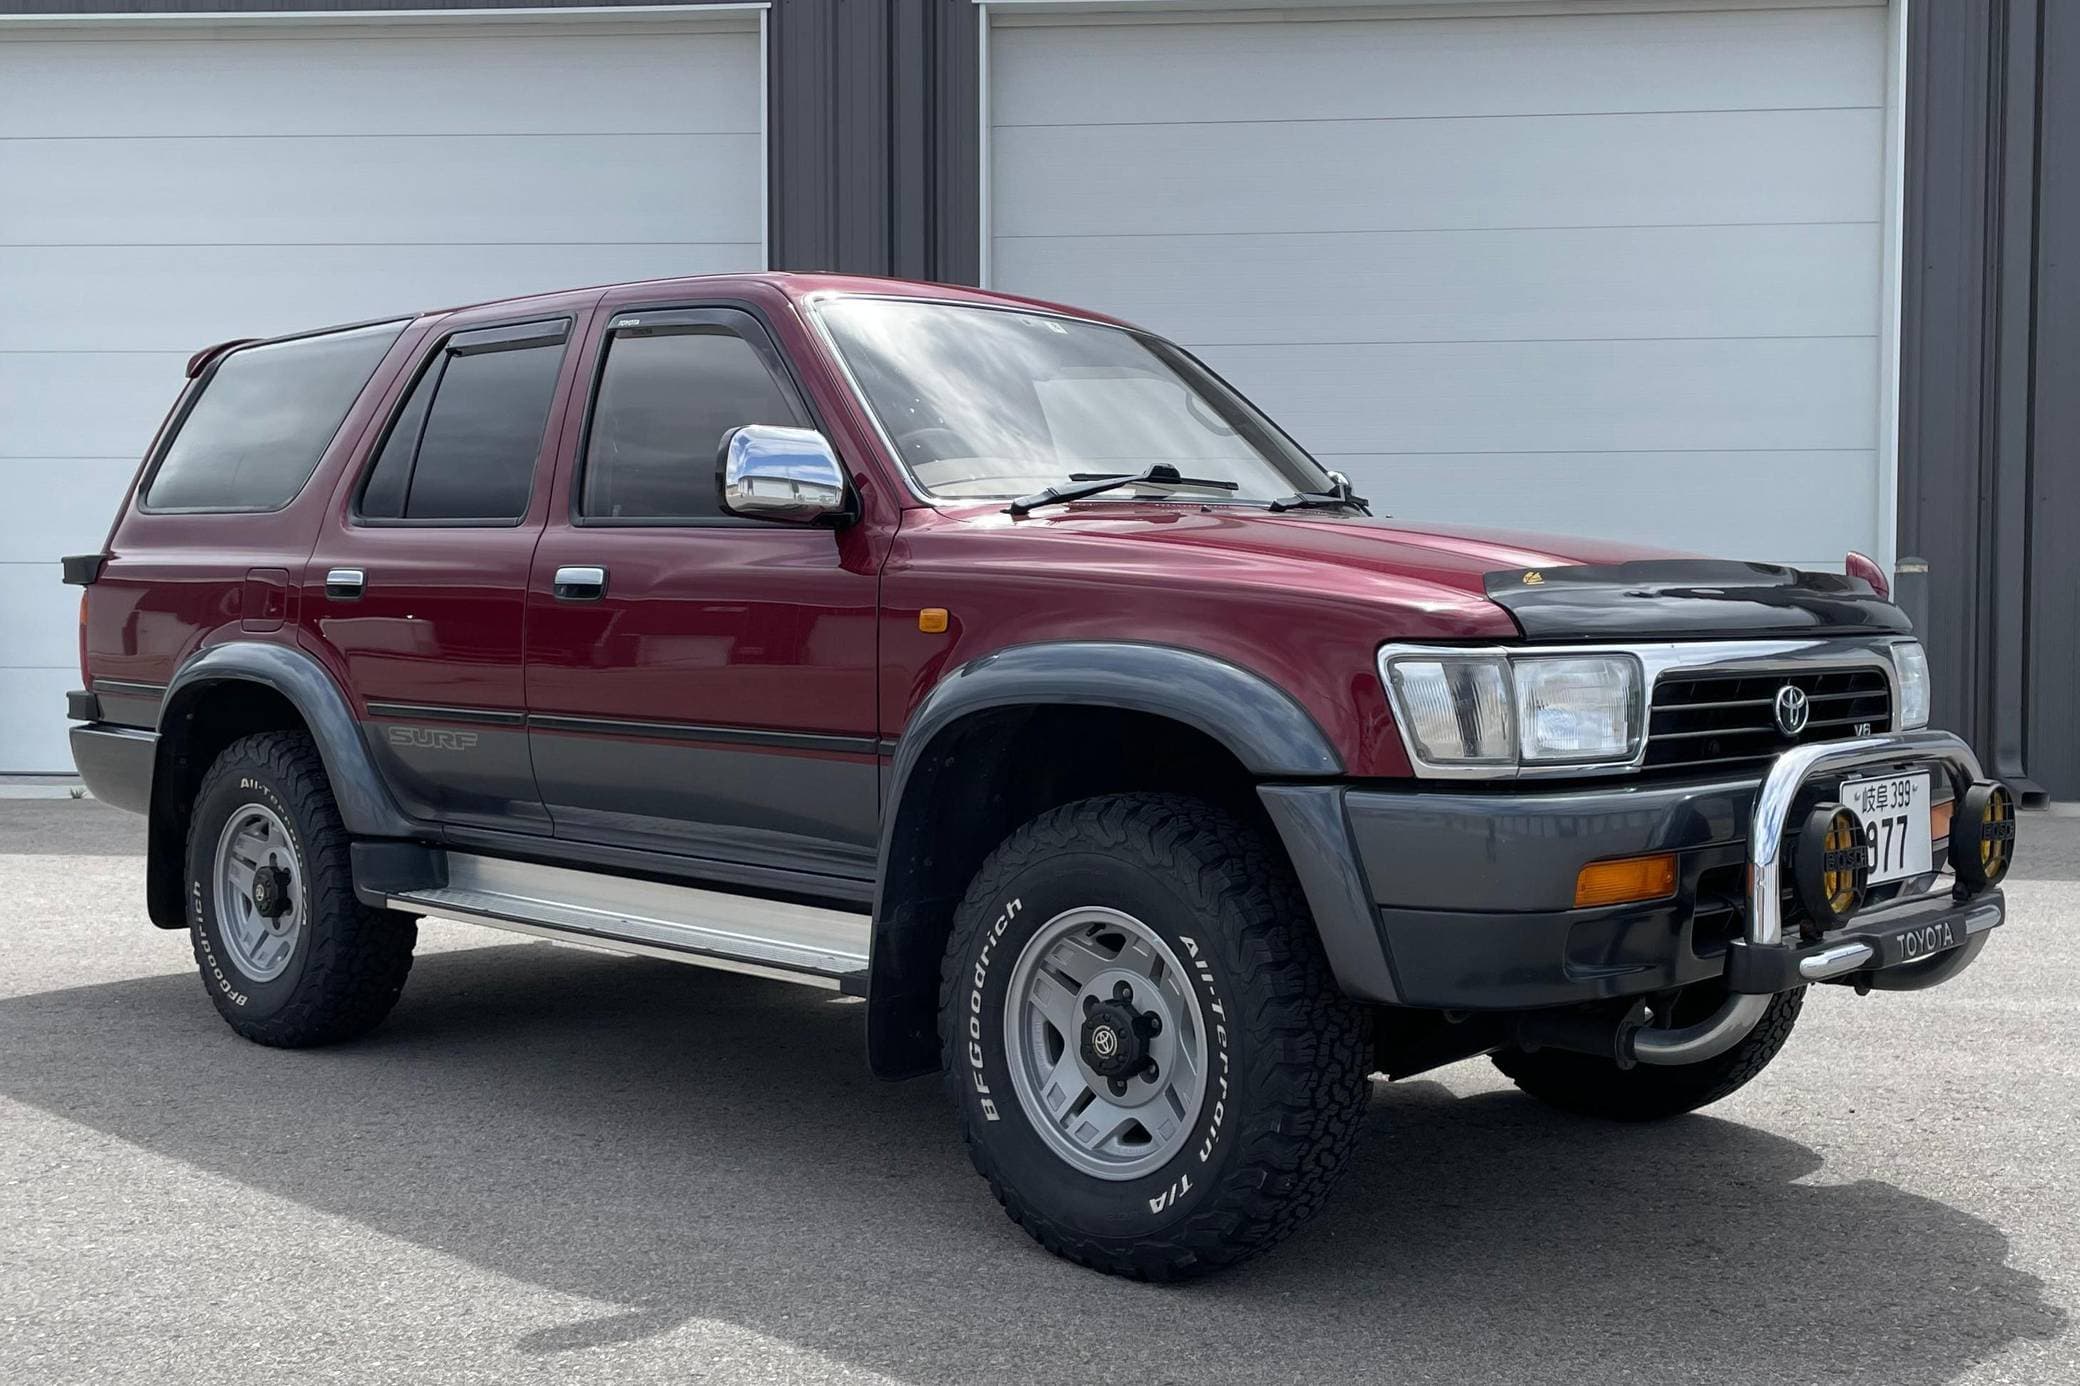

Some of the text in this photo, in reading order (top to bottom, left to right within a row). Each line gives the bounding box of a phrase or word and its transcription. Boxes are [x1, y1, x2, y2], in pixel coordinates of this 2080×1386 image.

[388, 726, 479, 751] SURF
[1854, 722, 1871, 737] V6
[1862, 779, 1911, 814] 岐阜 399
[1896, 922, 1954, 958] TOYOTA
[968, 897, 1023, 1122] BFGoodrich
[1149, 935, 1229, 1215] All-Terrain T/A
